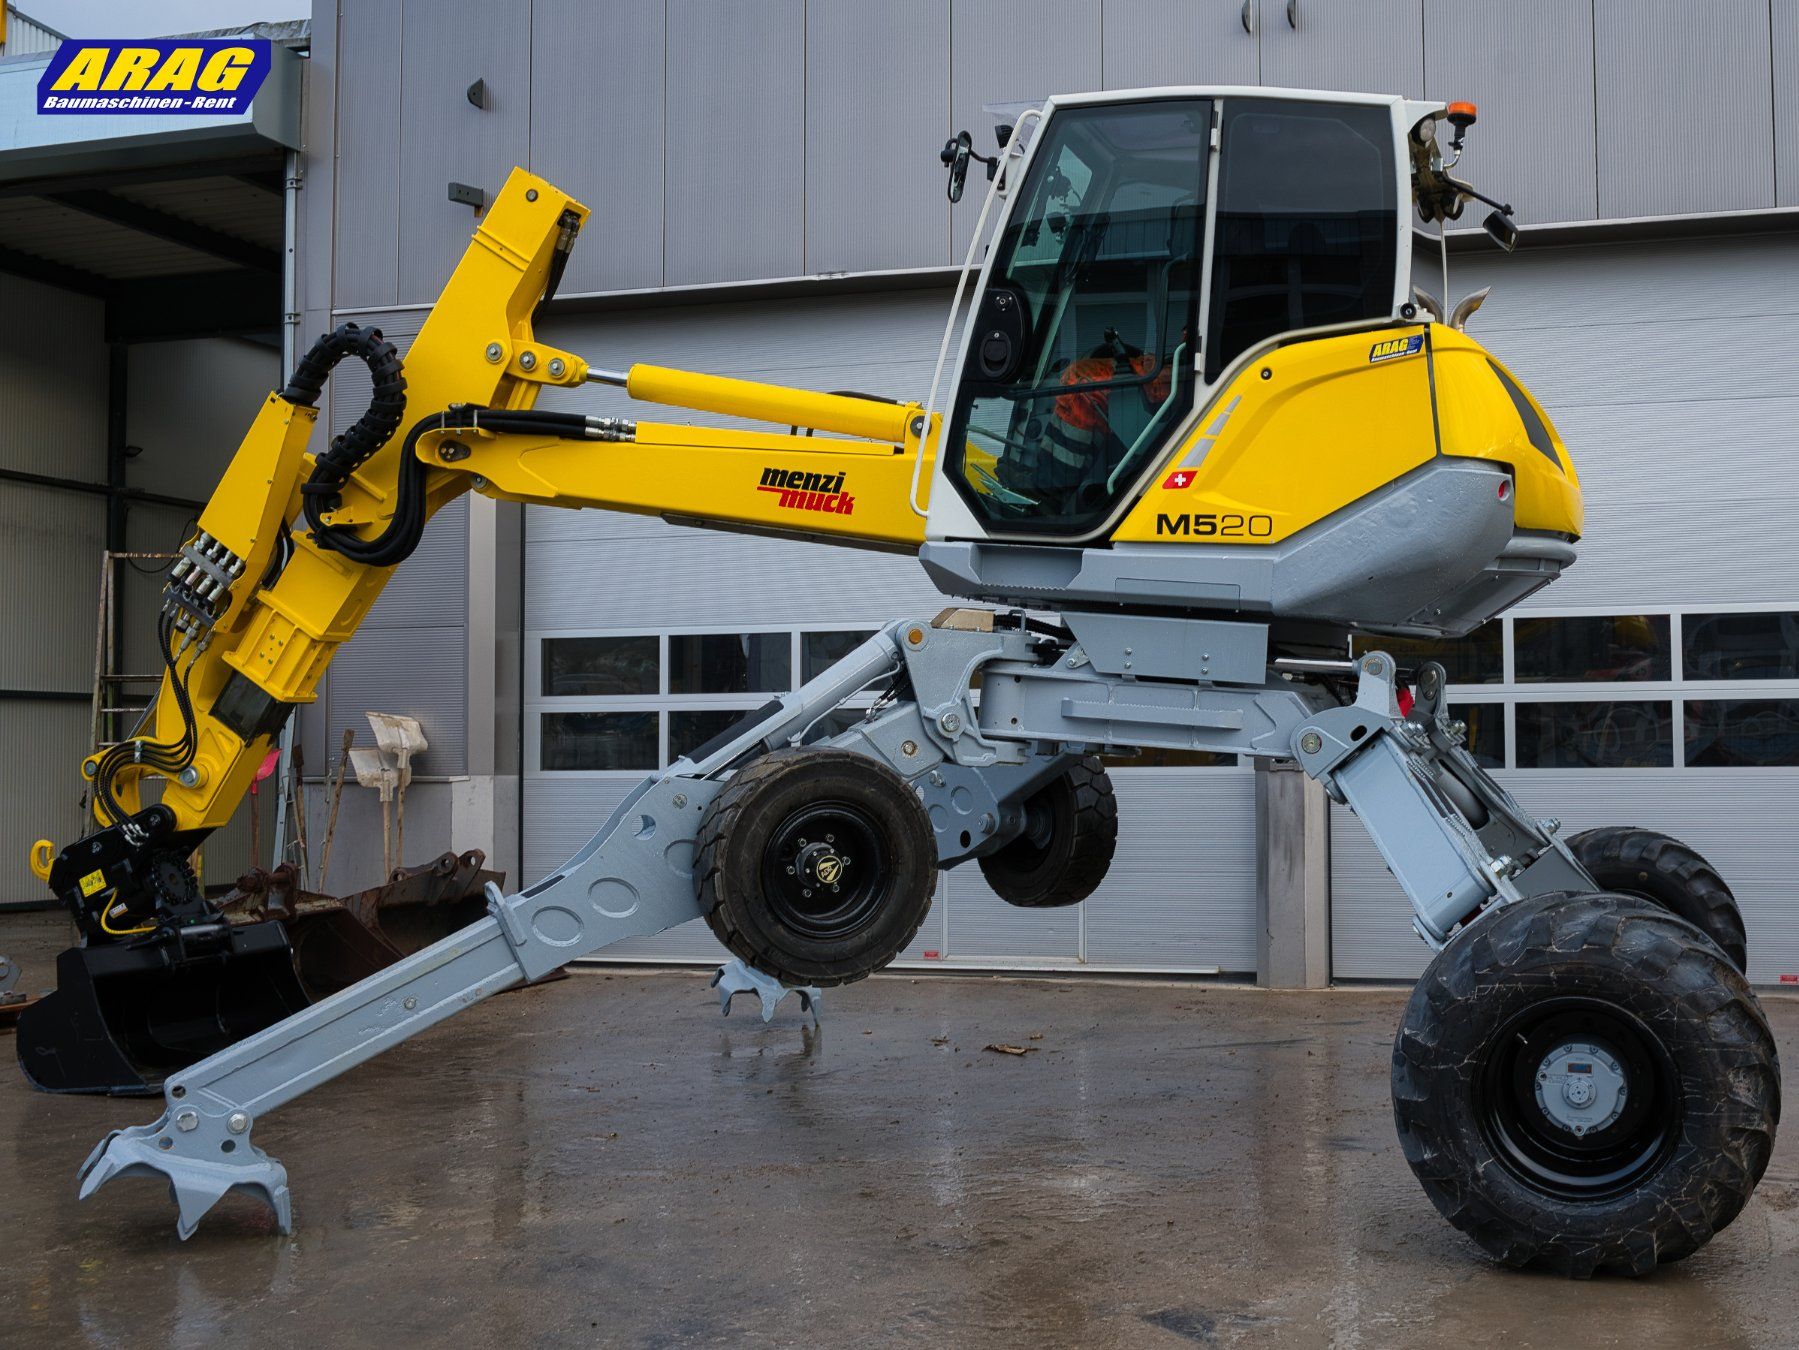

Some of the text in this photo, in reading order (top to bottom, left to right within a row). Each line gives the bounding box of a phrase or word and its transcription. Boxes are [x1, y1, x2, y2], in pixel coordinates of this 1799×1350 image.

[1373, 338, 1409, 358] ARAG
[760, 467, 847, 494] menzi
[778, 490, 855, 515] muck
[1156, 513, 1272, 536] M520
